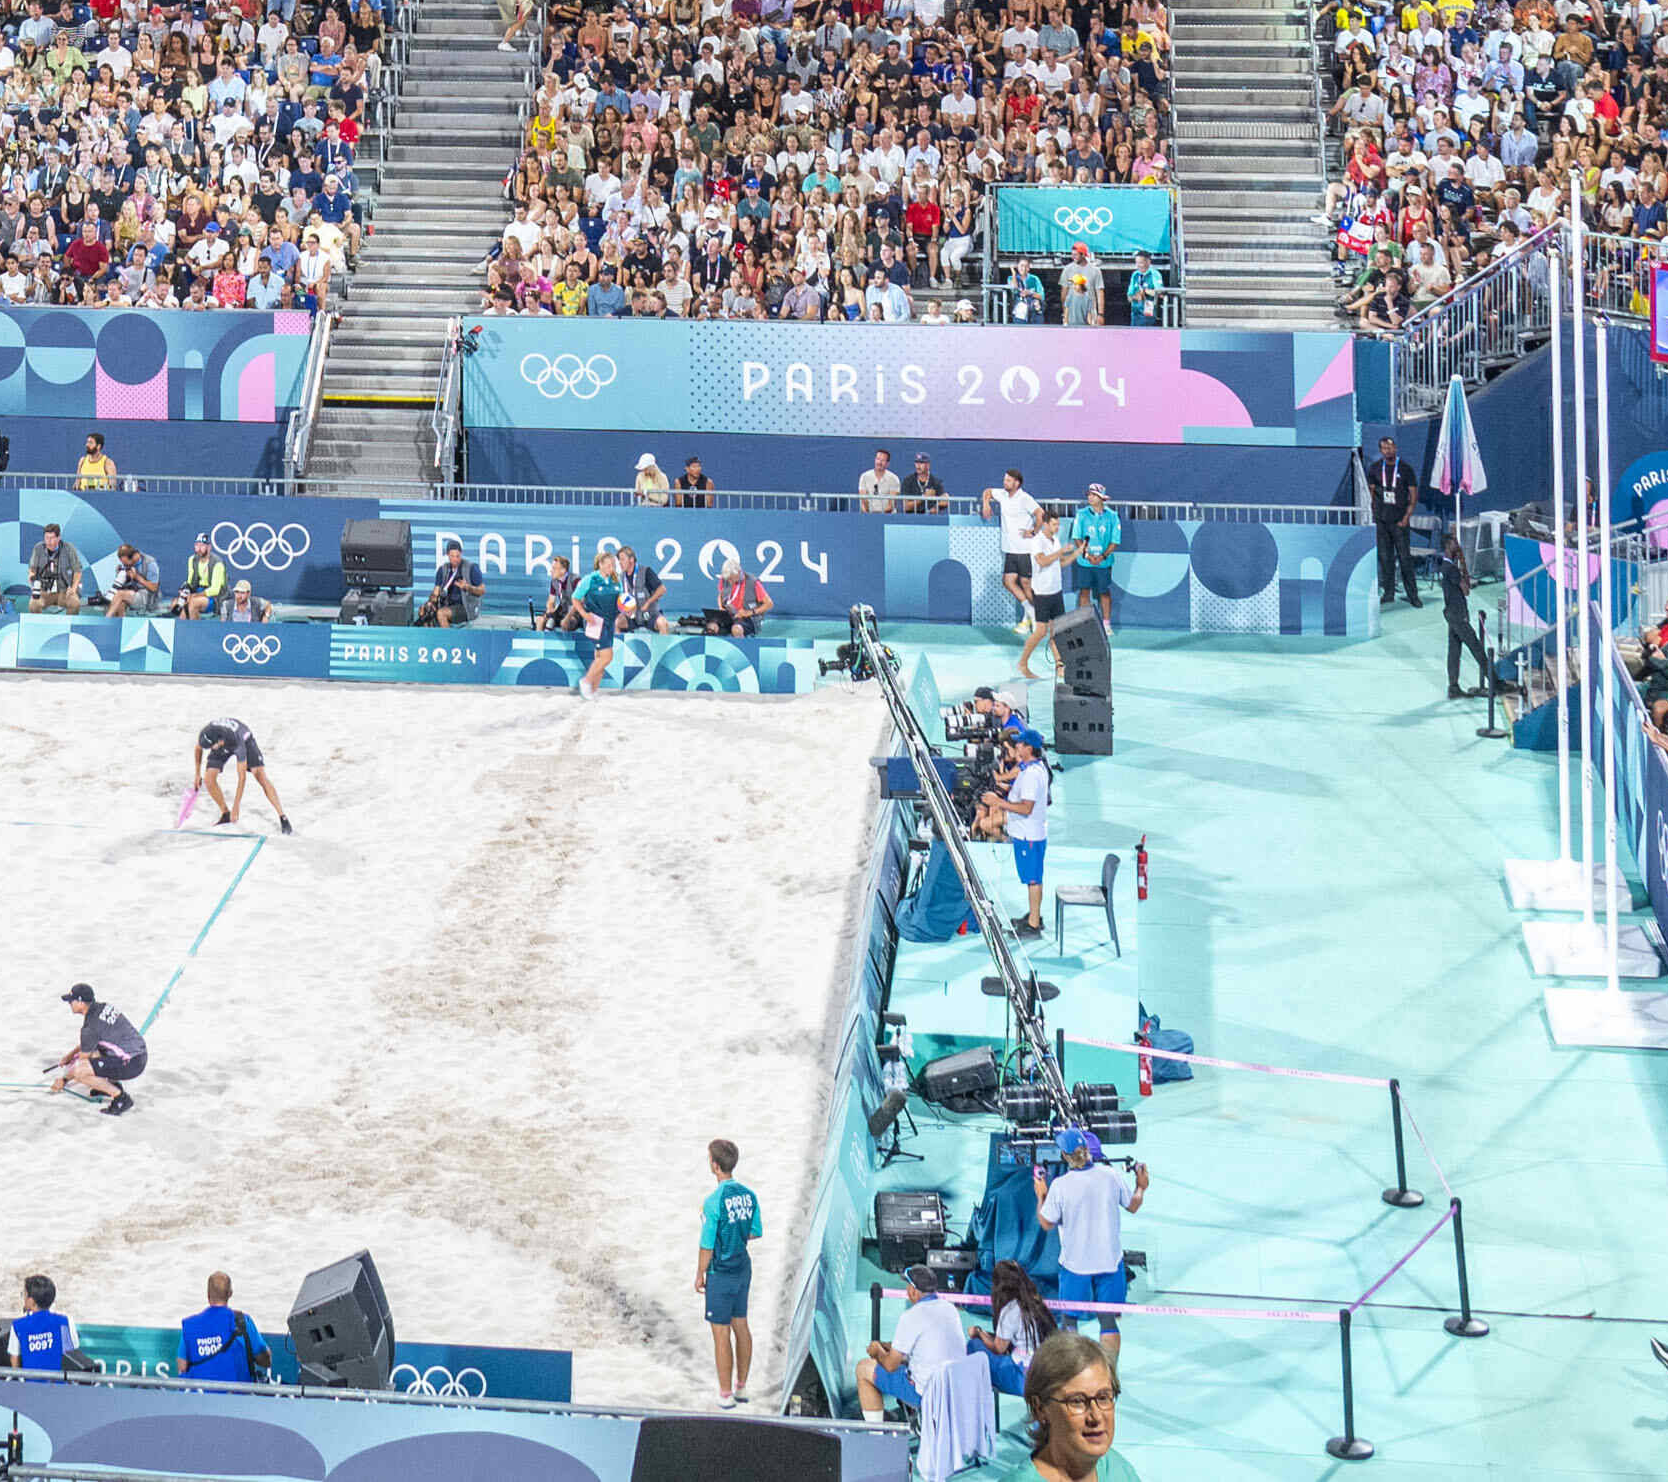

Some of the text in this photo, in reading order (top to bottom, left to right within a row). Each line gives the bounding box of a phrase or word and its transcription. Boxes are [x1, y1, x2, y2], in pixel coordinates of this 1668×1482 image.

[957, 364, 1127, 407] 2024
[655, 538, 828, 583] 2024
[417, 647, 477, 665] 2024
